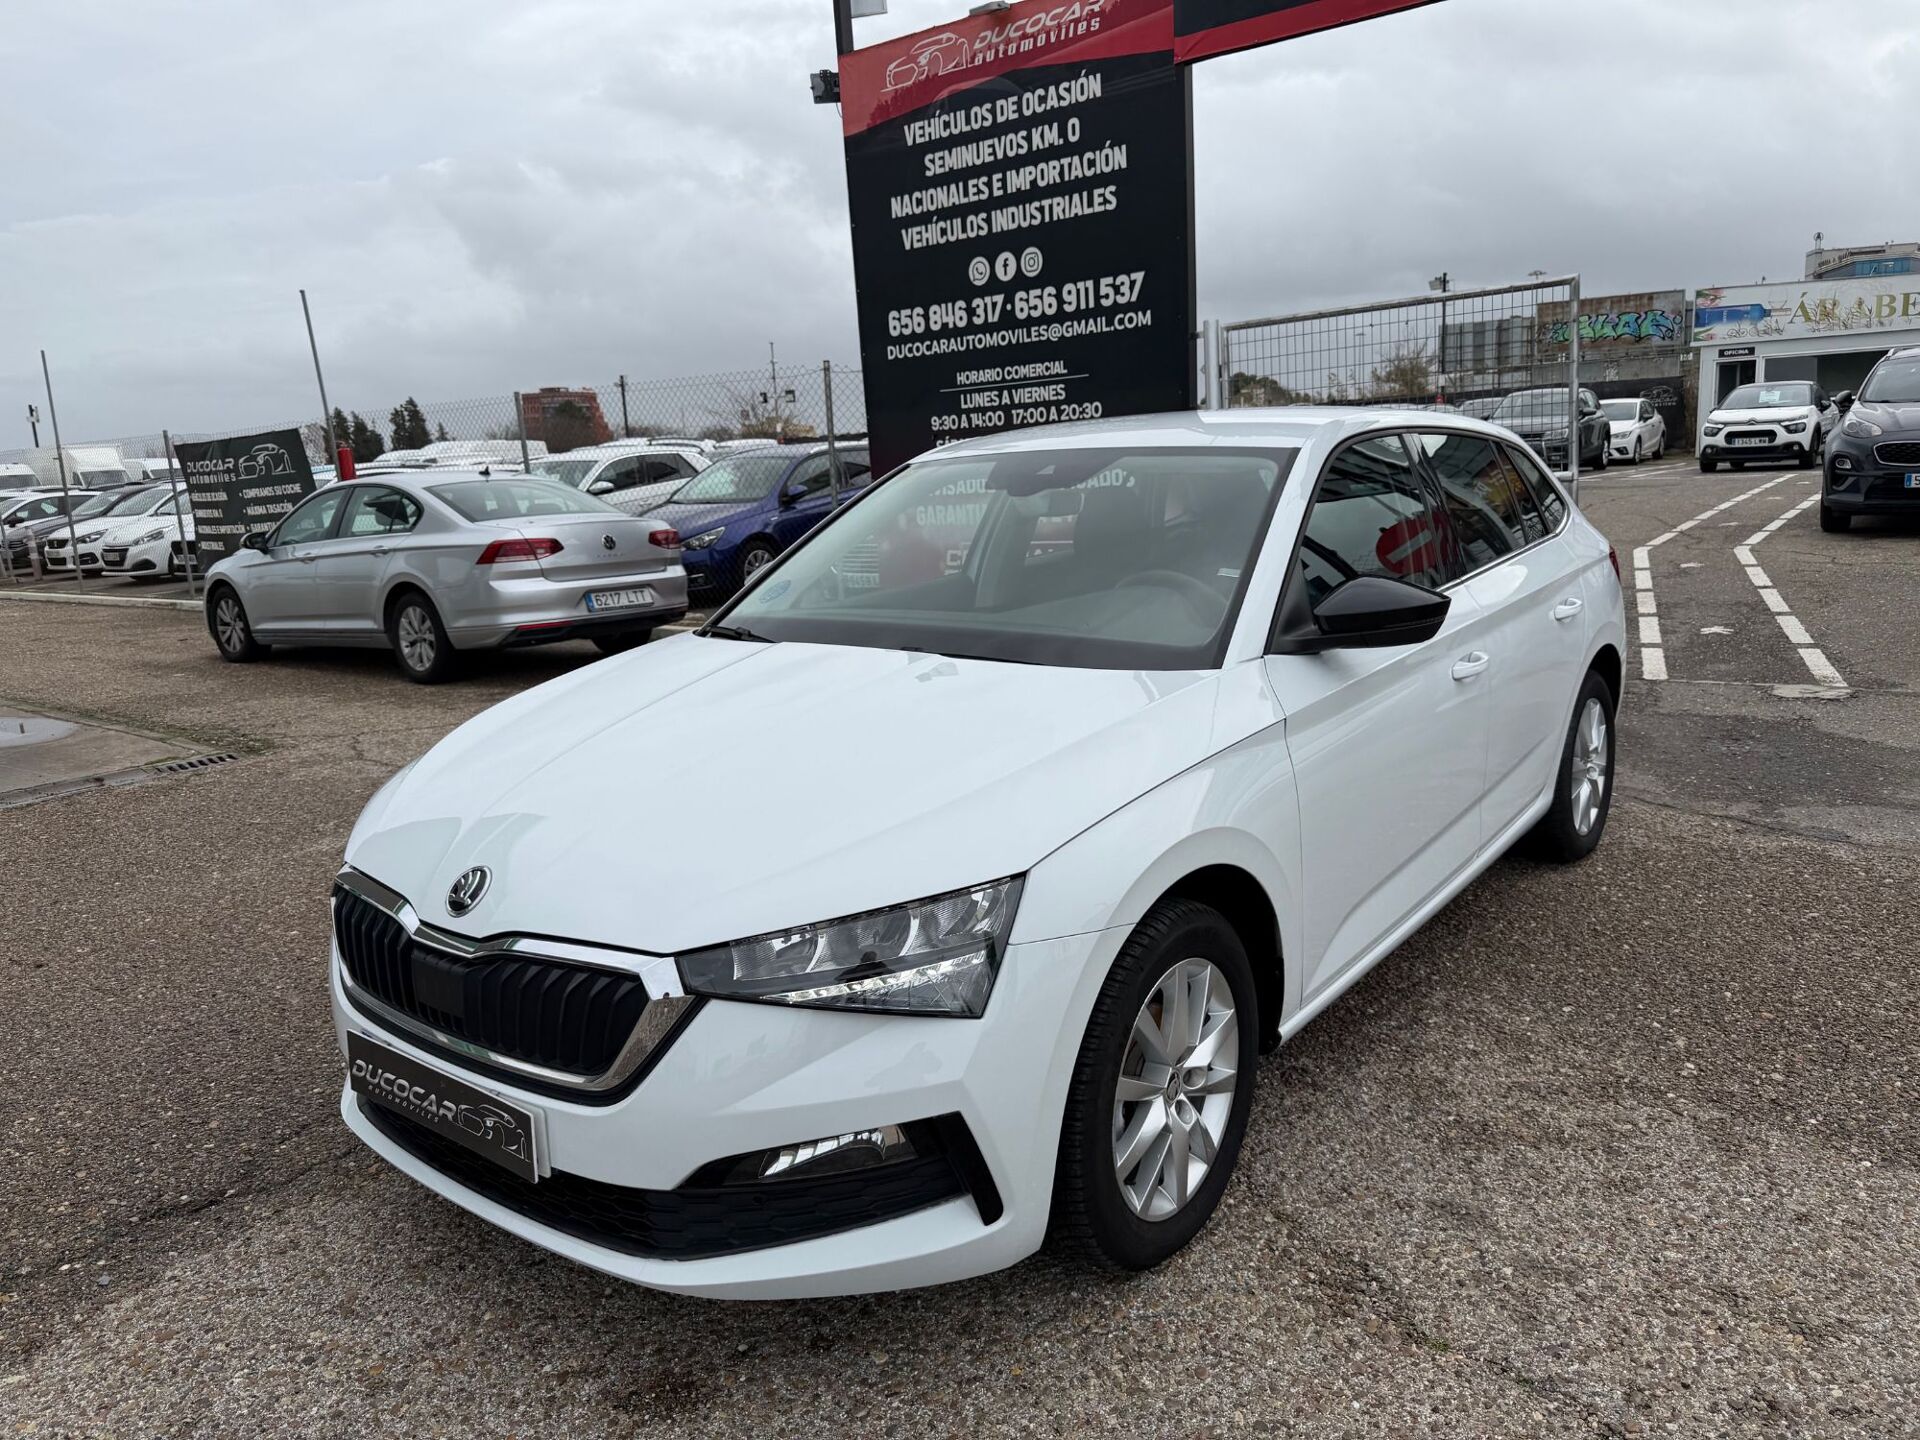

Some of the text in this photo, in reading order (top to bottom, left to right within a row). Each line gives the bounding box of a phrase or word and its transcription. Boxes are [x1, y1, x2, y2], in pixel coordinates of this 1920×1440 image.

[973, 0, 1104, 49] DUCOCAR
[903, 69, 1102, 146] VEHÍCULOS DE OCASIÓN
[924, 130, 1028, 177] SEMINUEVOS
[1031, 122, 1064, 151] KM.
[891, 140, 1127, 219] NACIONALES E IMPORTACIÓN
[901, 185, 1117, 250] VEHÍCULOS INDUSTRIALES
[888, 307, 925, 337] 656
[929, 300, 968, 331] 846
[1062, 280, 1095, 312] 911
[1100, 271, 1145, 307] 537
[887, 310, 1151, 360] DUCOCARAUTOMOVILES@GMAIL.COM
[1724, 348, 1749, 356] OFICINA
[956, 360, 1068, 385] HORARIO COMERCIAL
[960, 384, 1066, 409] LUNES A VIERNES
[931, 401, 1102, 431] 9:30 A 14:00 17:00 A 20:30
[187, 458, 235, 473] DUCOCAR
[594, 589, 646, 607] 6217 LTT
[351, 1059, 457, 1121] DUCOCAR
